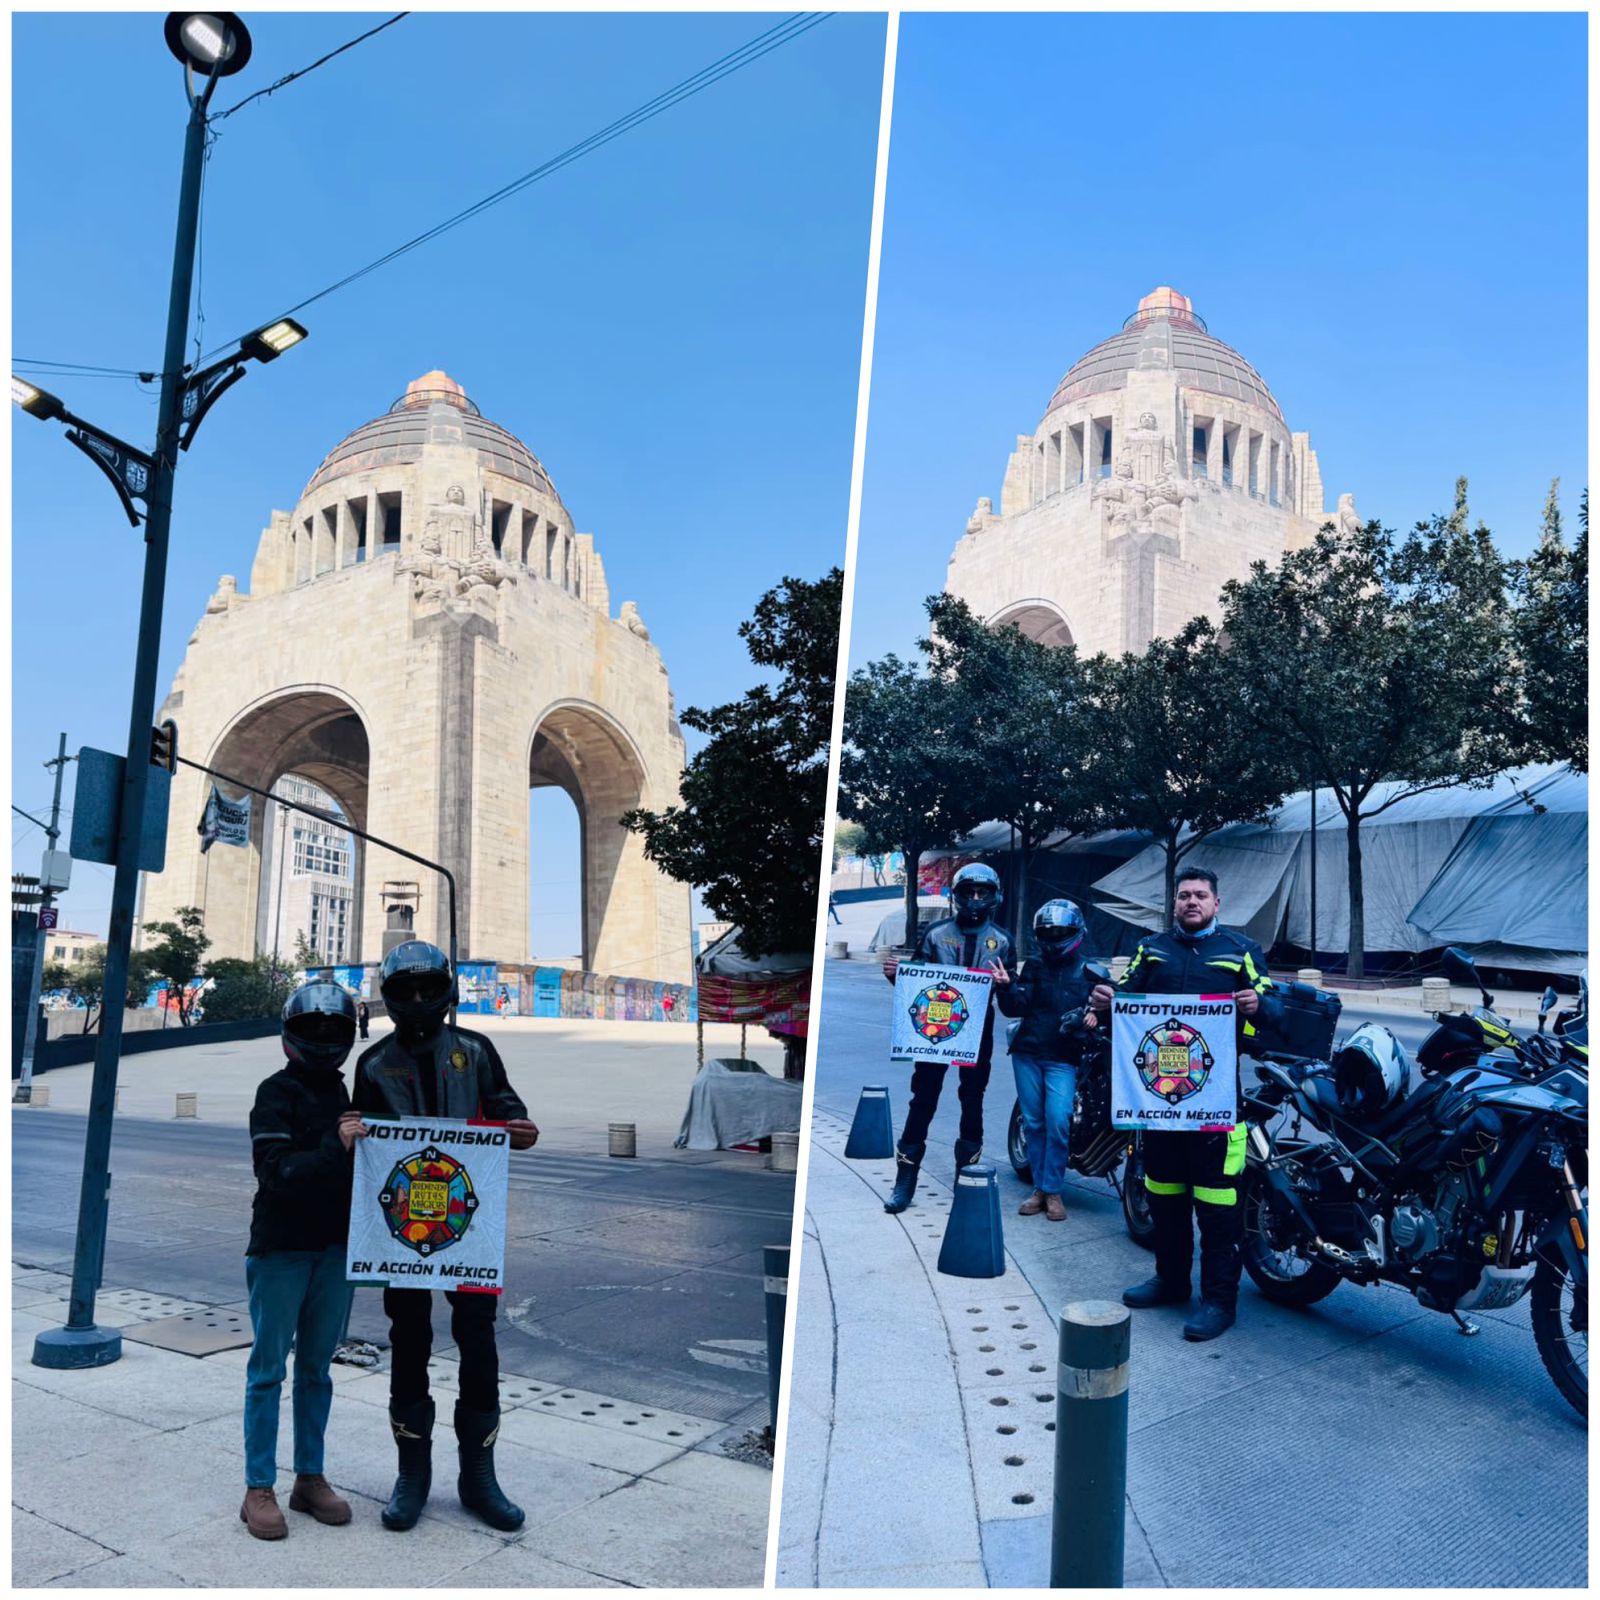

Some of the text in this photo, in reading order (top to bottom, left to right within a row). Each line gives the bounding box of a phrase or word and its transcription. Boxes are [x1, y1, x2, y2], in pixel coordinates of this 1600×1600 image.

[898, 967, 991, 985] MOTOTURISMO
[1114, 1002, 1233, 1016] MOTOTURISMO
[892, 1045, 976, 1059] EN ACCIÓN MÉXICO
[1116, 1107, 1232, 1120] EN ACCIÓN MÉXICO
[364, 1124, 506, 1146] MOTOTURISMO
[426, 1150, 436, 1159] N
[381, 1194, 391, 1202] O
[467, 1199, 476, 1207] E
[421, 1243, 430, 1252] S
[351, 1260, 498, 1279] EN ACCIÓN MÉXICO
